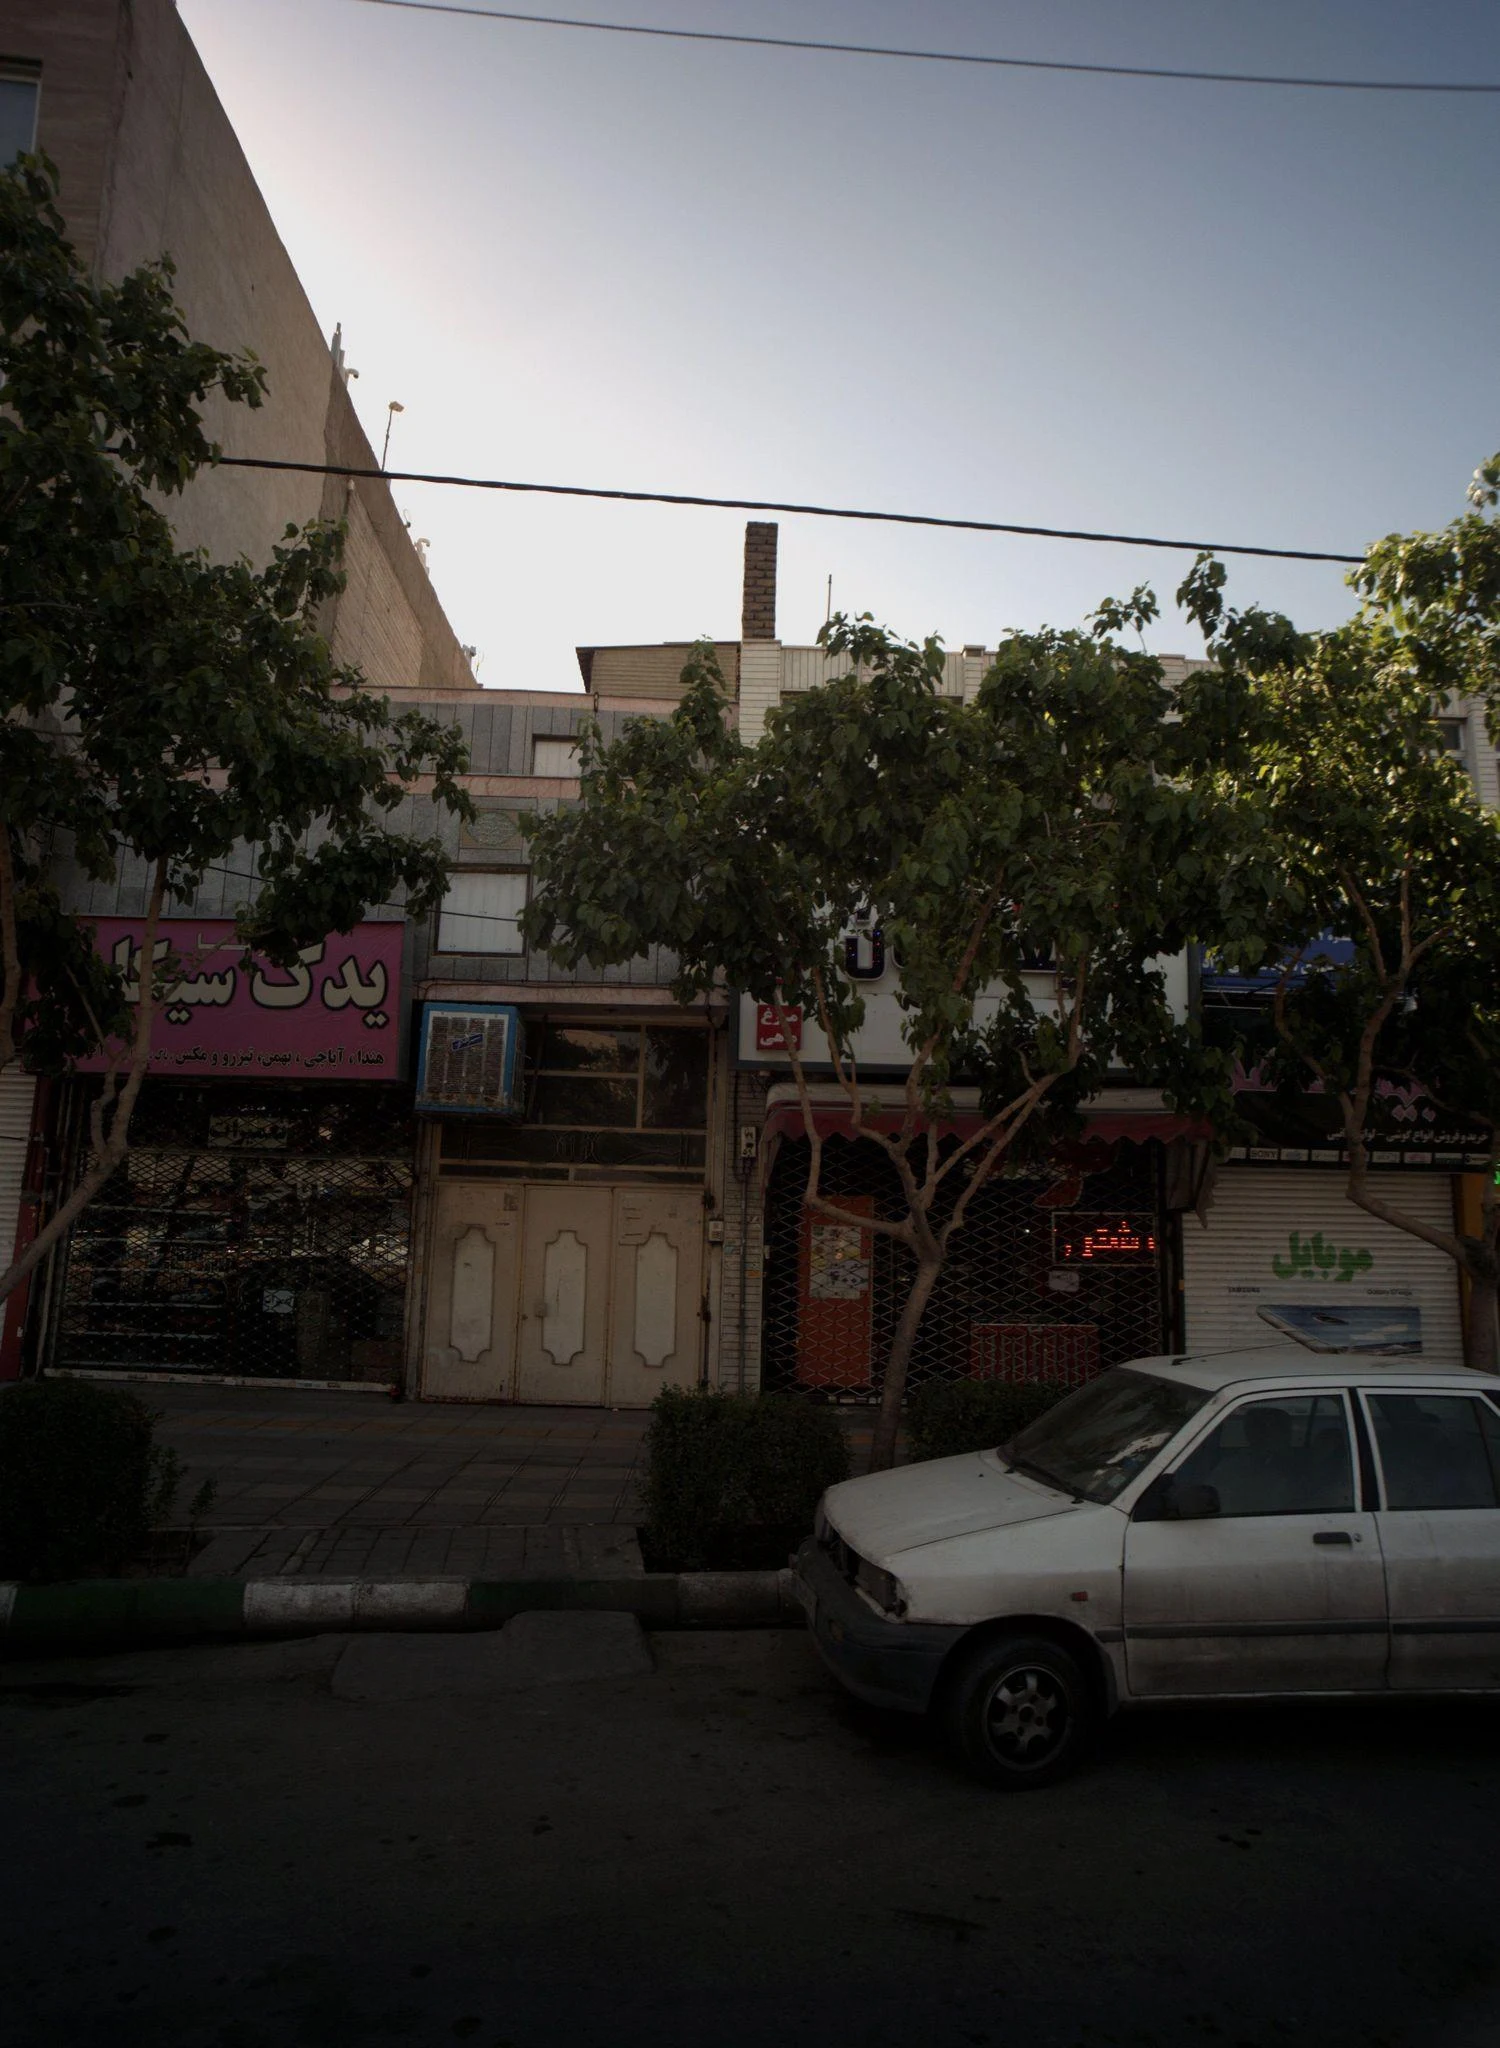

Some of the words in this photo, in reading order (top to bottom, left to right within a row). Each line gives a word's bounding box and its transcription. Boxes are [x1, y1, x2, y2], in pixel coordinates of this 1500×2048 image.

[252, 934, 390, 1029] یدک
[760, 1007, 799, 1026] مغ
[1272, 1231, 1374, 1282] موبایل
